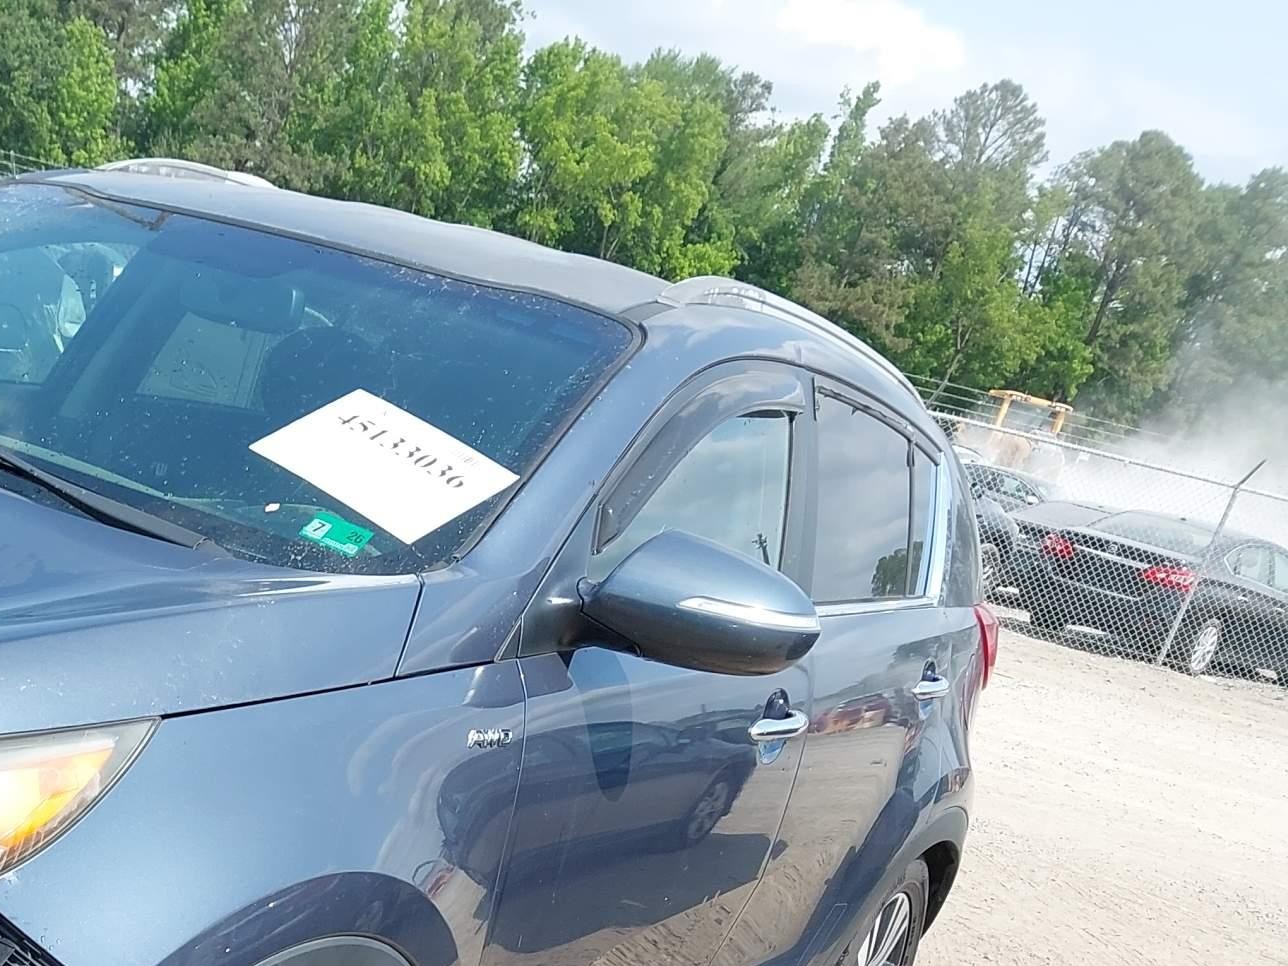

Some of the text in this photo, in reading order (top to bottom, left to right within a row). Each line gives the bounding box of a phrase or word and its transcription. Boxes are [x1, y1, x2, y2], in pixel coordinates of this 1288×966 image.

[337, 414, 465, 489] 45133036
[312, 521, 326, 533] 7
[346, 531, 365, 544] 26
[467, 728, 513, 749] AWD
